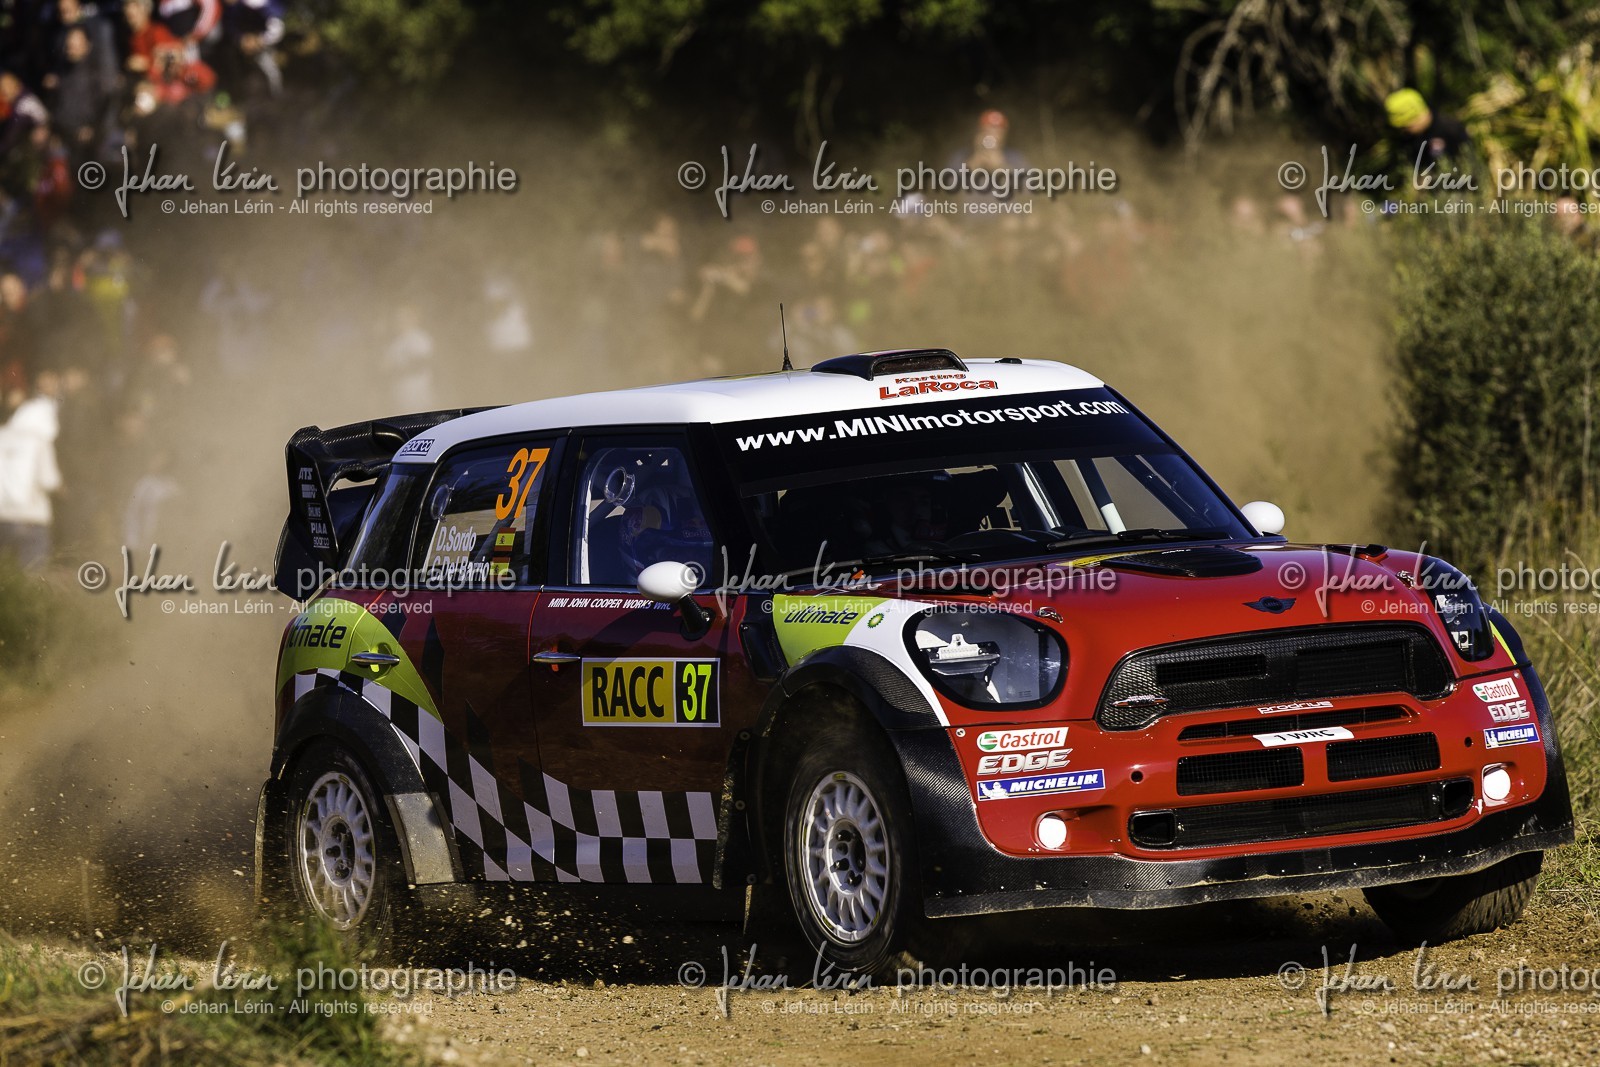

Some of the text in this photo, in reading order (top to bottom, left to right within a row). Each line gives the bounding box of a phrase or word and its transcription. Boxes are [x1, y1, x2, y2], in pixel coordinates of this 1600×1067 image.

[878, 380, 998, 400] LaRoca
[735, 399, 1129, 452] www.MINImotorsport.com
[496, 448, 550, 520] 37
[436, 525, 477, 552] D.Sordo
[548, 598, 569, 608] MINI
[568, 598, 590, 608] JOHN
[590, 598, 623, 609] COOPER
[623, 599, 654, 609] WORKS
[783, 604, 859, 625] ultimate
[592, 666, 665, 718] RACC
[682, 663, 712, 721] 37
[1483, 681, 1516, 699] Castrol
[1257, 701, 1334, 714] prodrive
[1487, 700, 1530, 722] EDGE
[1000, 730, 1061, 749] Castrol
[1287, 729, 1335, 740] WRC
[1497, 727, 1535, 741] MICHELIN
[976, 748, 1073, 775] EDGE
[1009, 773, 1099, 793] MICHELIN
